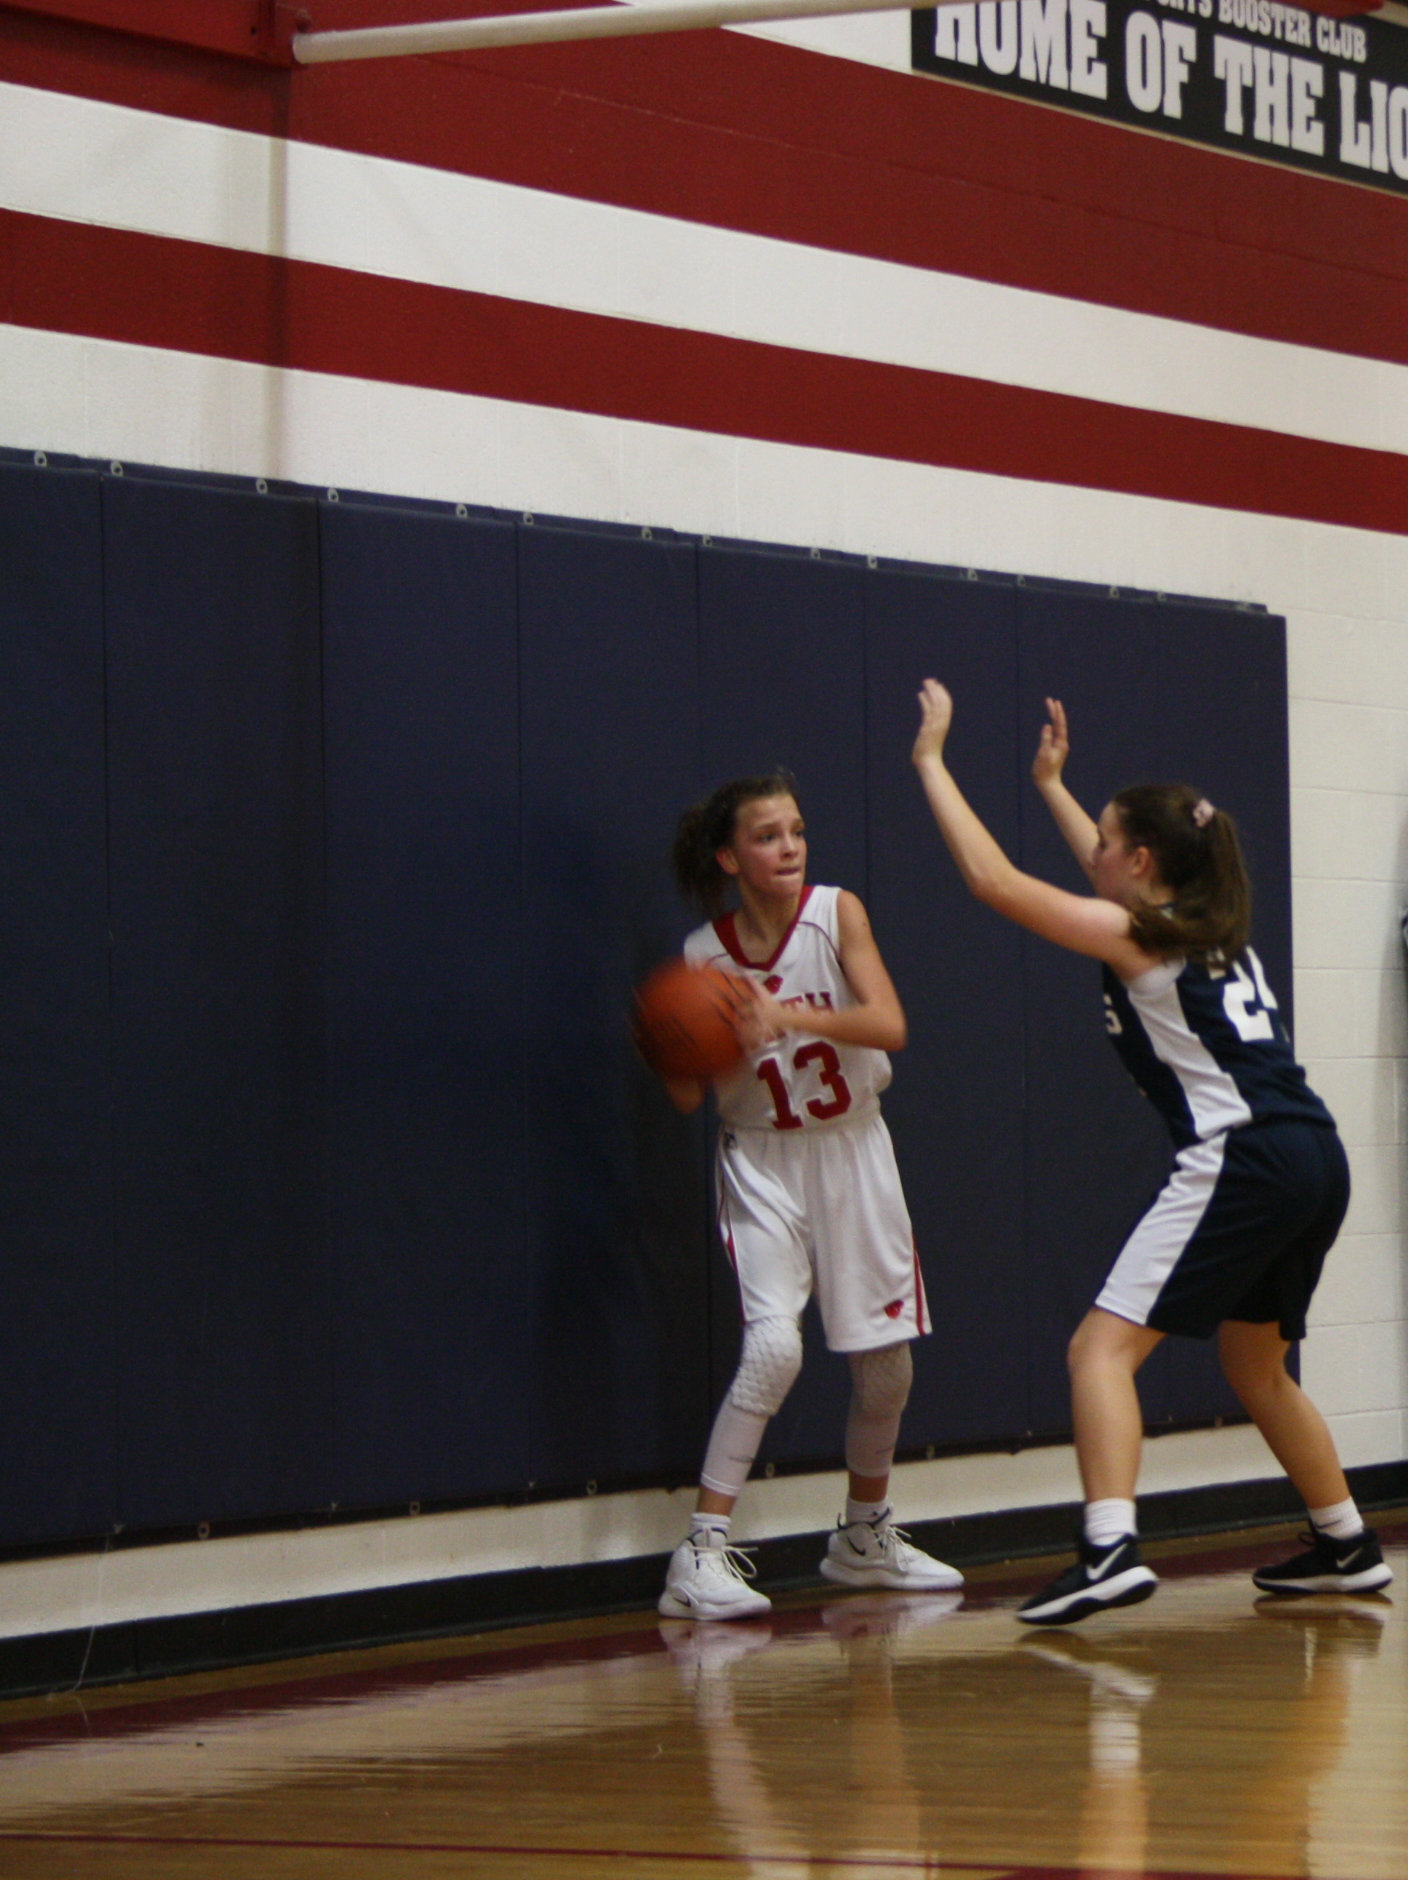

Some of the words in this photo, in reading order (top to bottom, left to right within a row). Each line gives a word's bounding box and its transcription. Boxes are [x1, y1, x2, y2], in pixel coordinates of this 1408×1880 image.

[1217, 0, 1312, 48] BOOSTER
[1316, 16, 1367, 63] CLUB
[1125, 10, 1197, 118] OF
[1214, 35, 1324, 156] THE
[756, 1040, 853, 1131] 13
